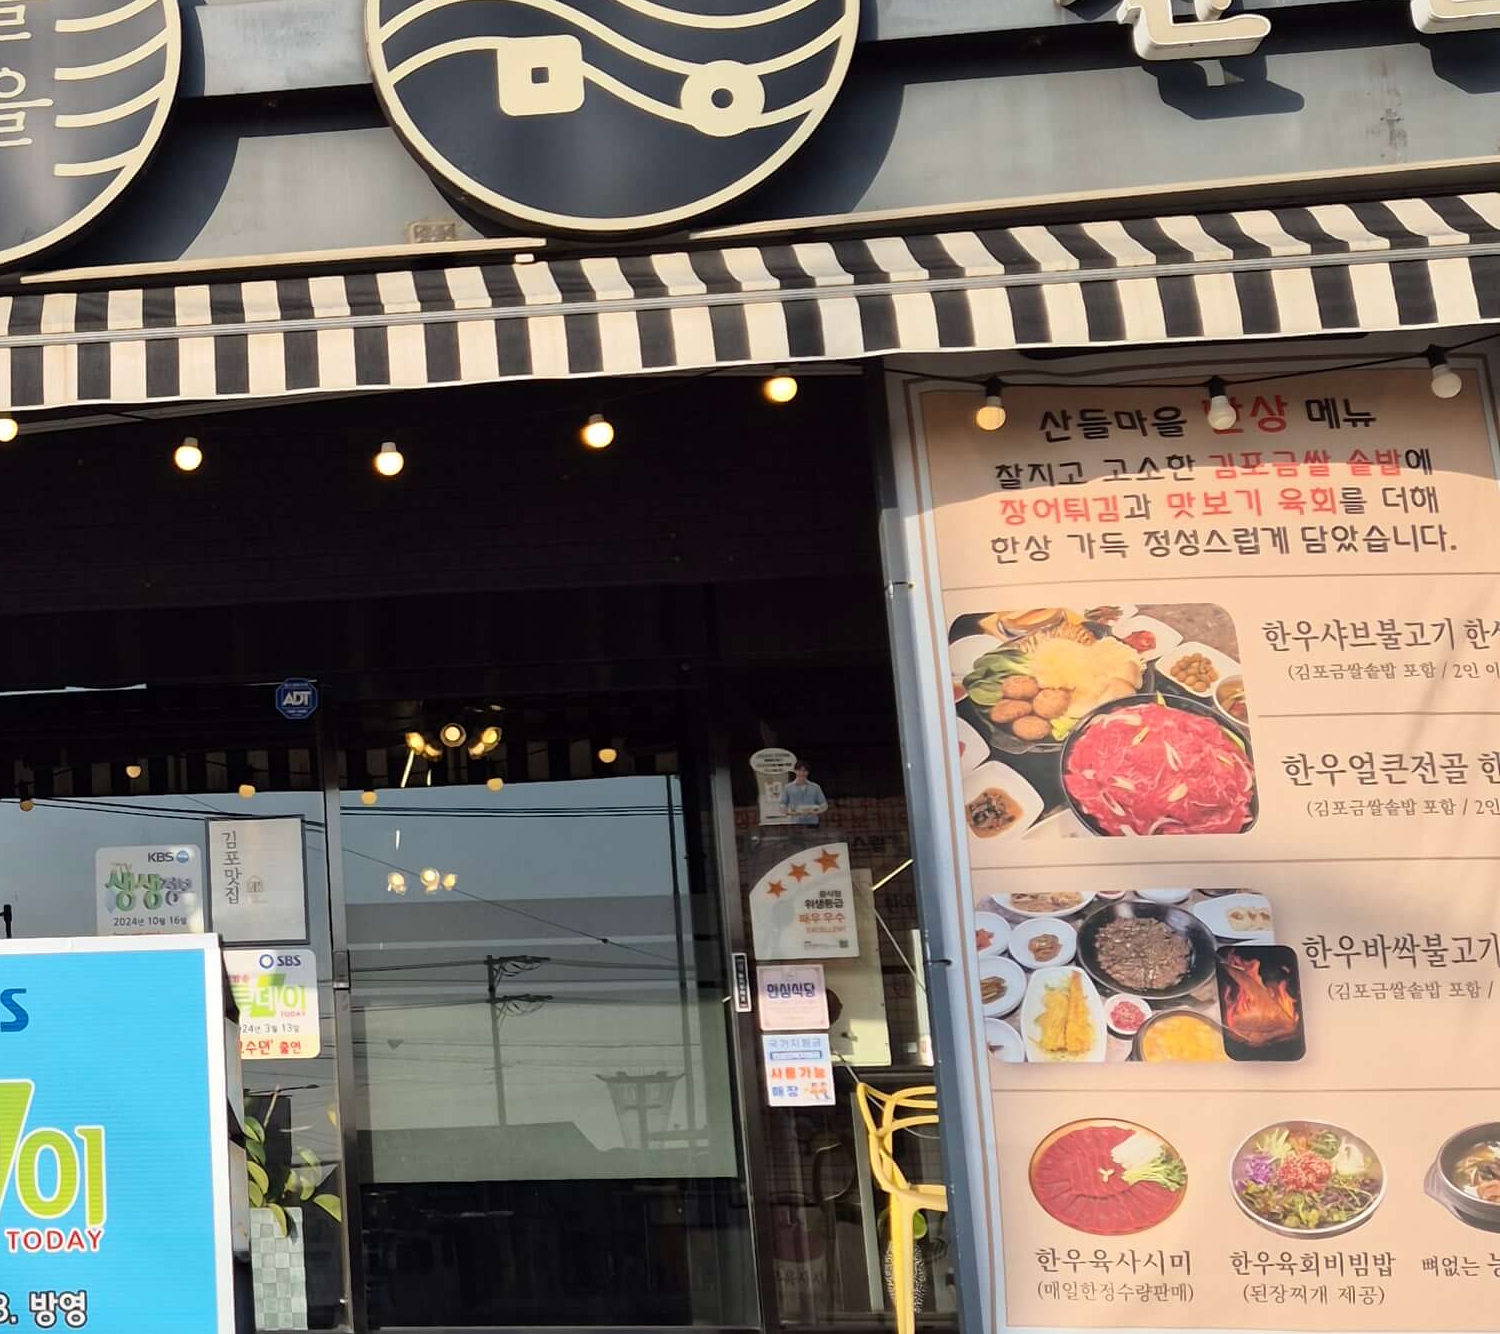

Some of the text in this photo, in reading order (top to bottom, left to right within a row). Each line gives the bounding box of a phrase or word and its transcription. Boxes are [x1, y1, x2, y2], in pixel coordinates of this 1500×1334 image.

[1039, 406, 1187, 443] 산들마을
[1305, 396, 1380, 431] 메뉴
[995, 446, 1434, 490] 찰지고 고소한 김포금쌀 솥밥에
[999, 485, 1439, 526] 장어튀김과 맛보기 육회를 더해
[990, 523, 1458, 565] 한상 가득 정성스럽게 담았습니다.
[1262, 617, 1455, 652] 한우샤브불고기
[1287, 662, 1397, 681] (김포금쌀솥밥
[1403, 661, 1437, 679] 포함
[1453, 662, 1480, 679] 2인
[282, 690, 311, 706] ADT
[1282, 751, 1468, 787] 한우얼큰전골
[1306, 798, 1417, 817] (김포금쌀솥밥
[1423, 797, 1457, 816] 포함
[148, 852, 174, 863] KBS
[222, 830, 243, 905] 김포맛집
[114, 917, 144, 927] 2024년
[277, 955, 302, 966] SBS
[1302, 932, 1500, 969] 한우바싹불고기
[766, 982, 816, 999] 안심식당
[1328, 981, 1442, 1000] (김포금쌀솥밥
[1448, 980, 1481, 999] 포함
[6, 1228, 104, 1254] TODAY
[1036, 1247, 1192, 1275] 한우육사시미
[1229, 1250, 1396, 1278] 한우육회비빔밥
[1421, 1255, 1480, 1277] 뼈없는
[1243, 1283, 1386, 1305] (된장찌개 제공)
[29, 1290, 89, 1328] 방영
